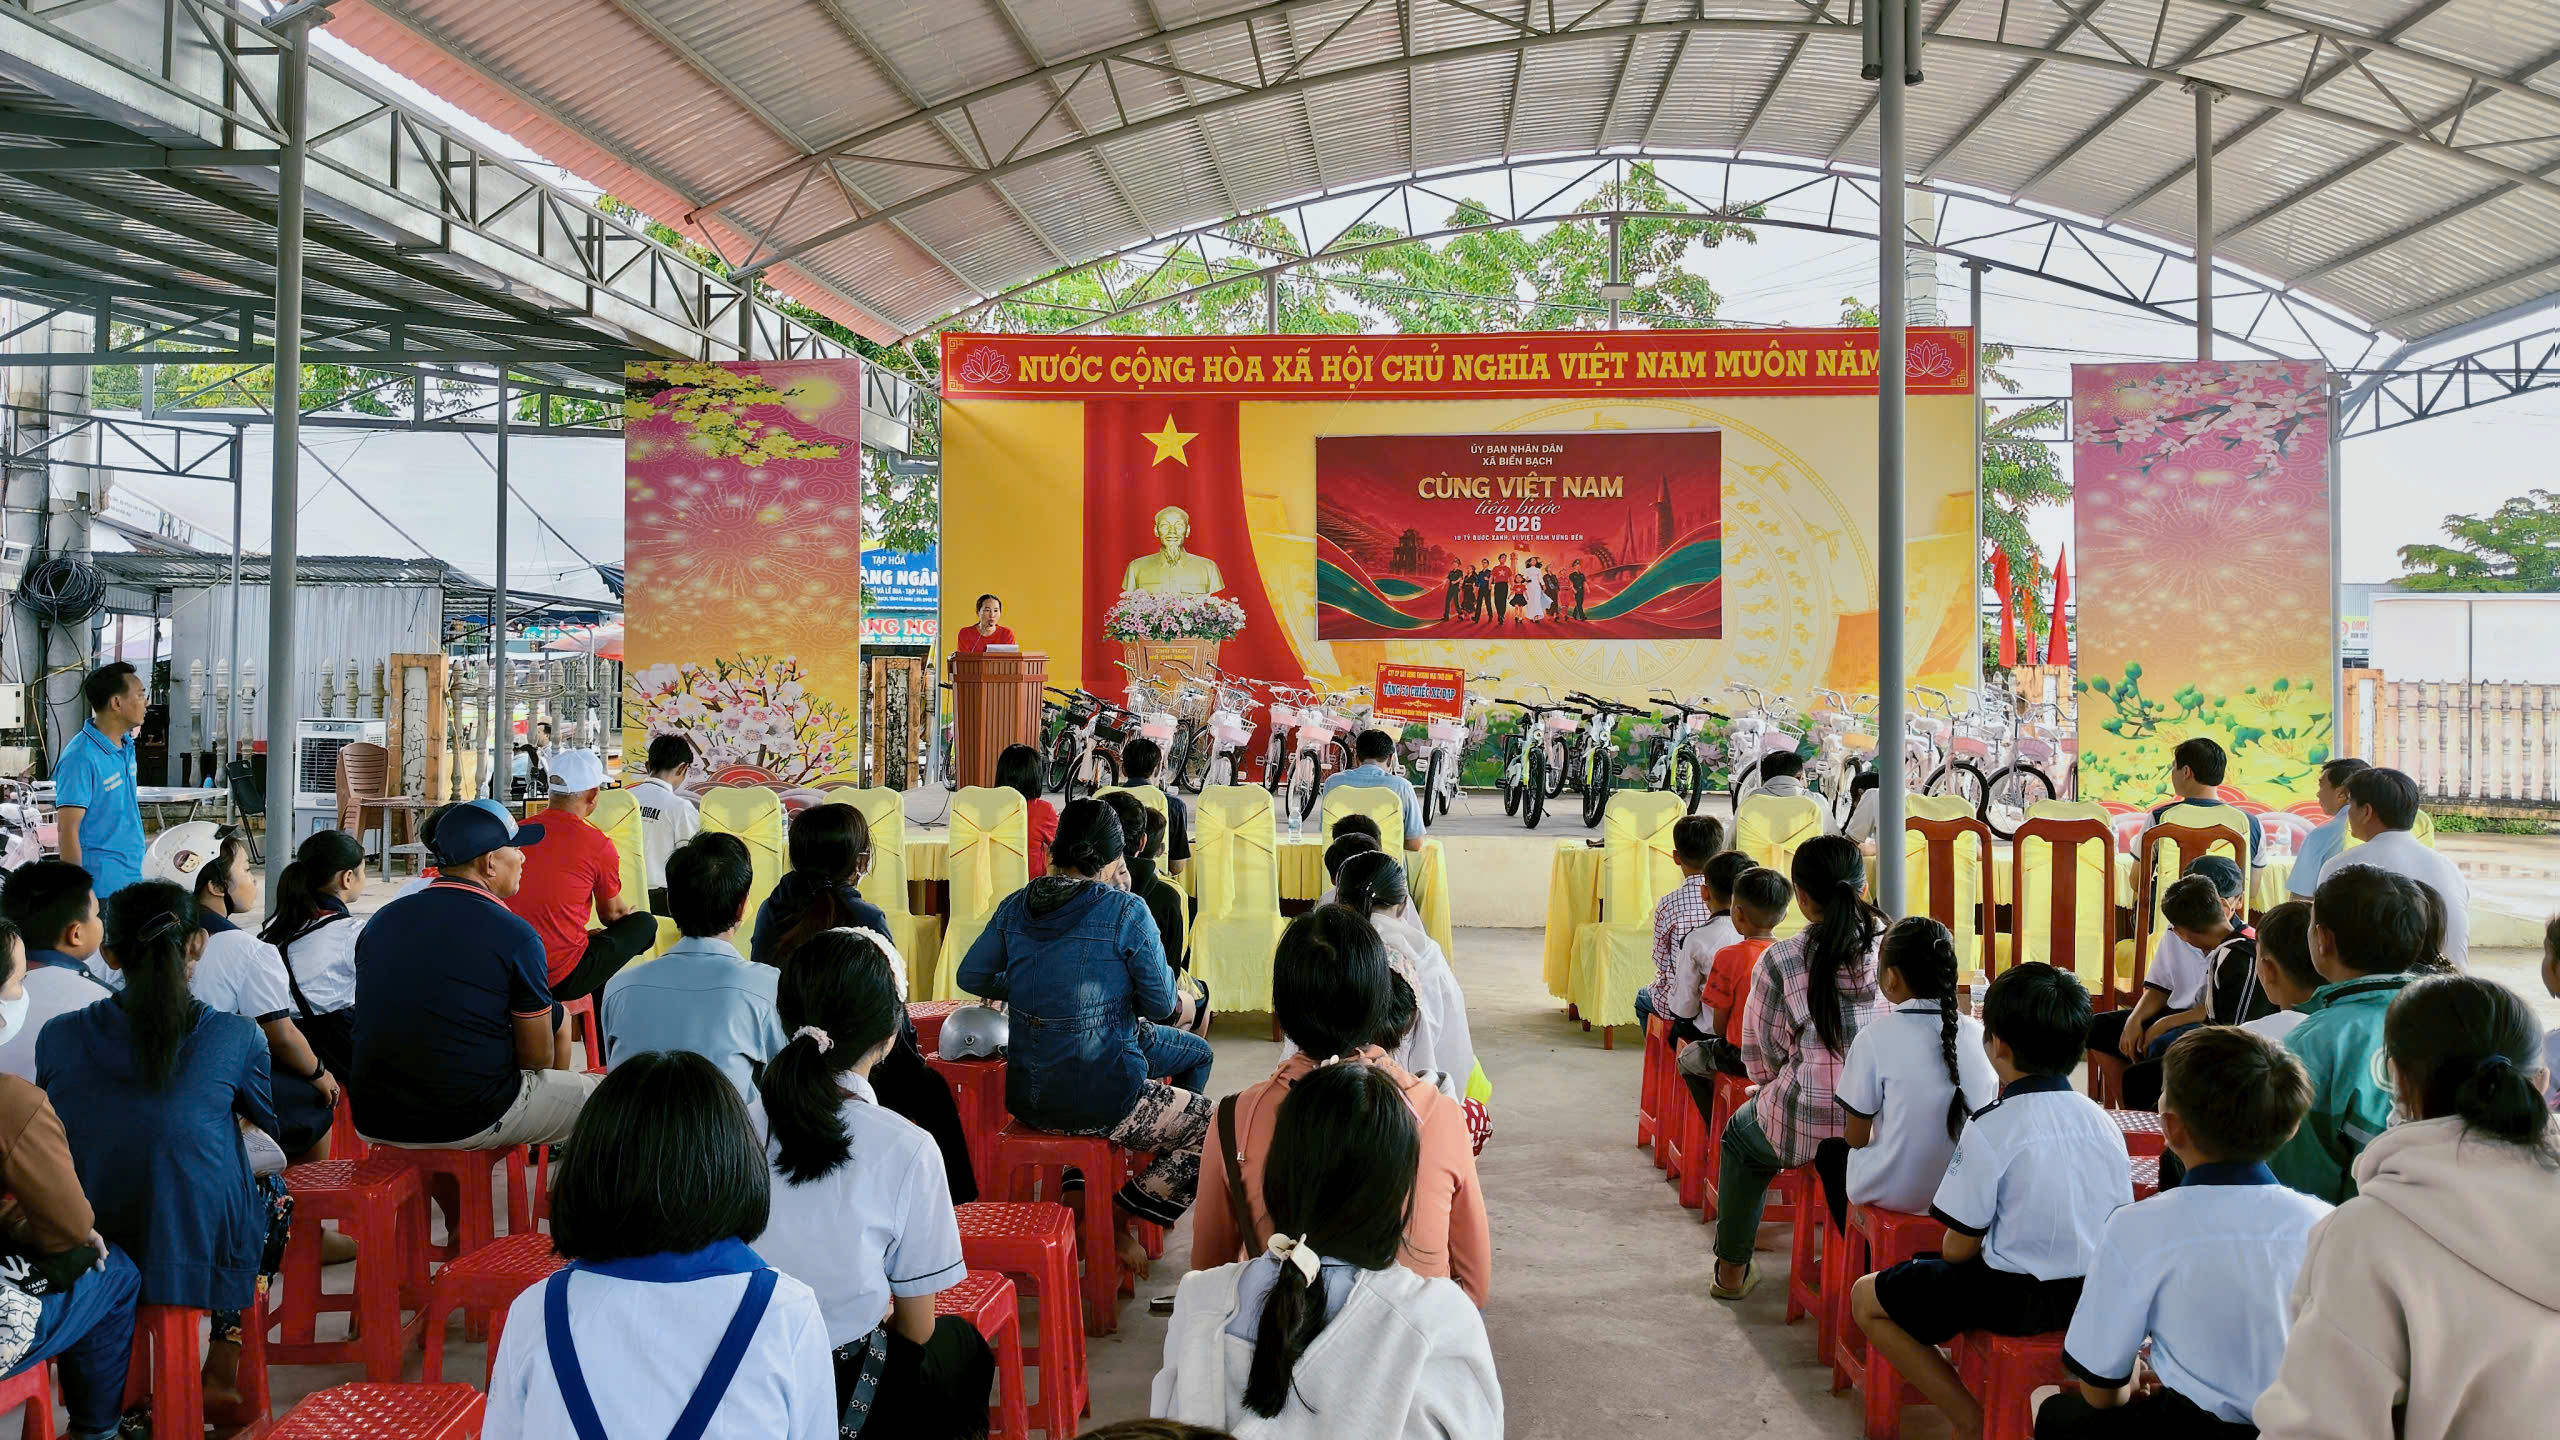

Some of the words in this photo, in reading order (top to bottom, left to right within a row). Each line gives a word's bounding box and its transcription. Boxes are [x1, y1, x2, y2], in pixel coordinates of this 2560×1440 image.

[1018, 345, 1103, 383] NƯỚC
[1110, 346, 1195, 390] CỘNG
[1203, 345, 1265, 383] HÒA
[1272, 347, 1314, 383] XÃ
[1321, 345, 1374, 390] HỘI
[1381, 342, 1444, 382] CHỦ
[1452, 344, 1551, 382] NGHĨA
[1558, 342, 1628, 387] VIỆT
[1636, 350, 1707, 379] NAM
[1715, 339, 1808, 377] MUÔN
[1816, 340, 1880, 377] NĂM
[1470, 442, 1484, 454] ỦY
[1486, 445, 1508, 454] BAN
[1510, 442, 1539, 454] NHÂN
[1541, 442, 1564, 454] DÂN
[1482, 455, 1496, 466] XÃ
[1499, 453, 1523, 466] BIỂN
[1525, 456, 1553, 468] BẠCH
[1418, 471, 1491, 500] CÙNG
[1496, 470, 1558, 503] VIỆT
[1562, 475, 1624, 499] NAM
[1474, 499, 1511, 515] tiến
[1515, 495, 1561, 516] bước
[1494, 516, 1542, 532] 2026
[1520, 533, 1534, 541] VIỆT
[872, 555, 887, 567] TẠP
[888, 554, 906, 565] HÓA
[1431, 687, 1440, 699] XE
